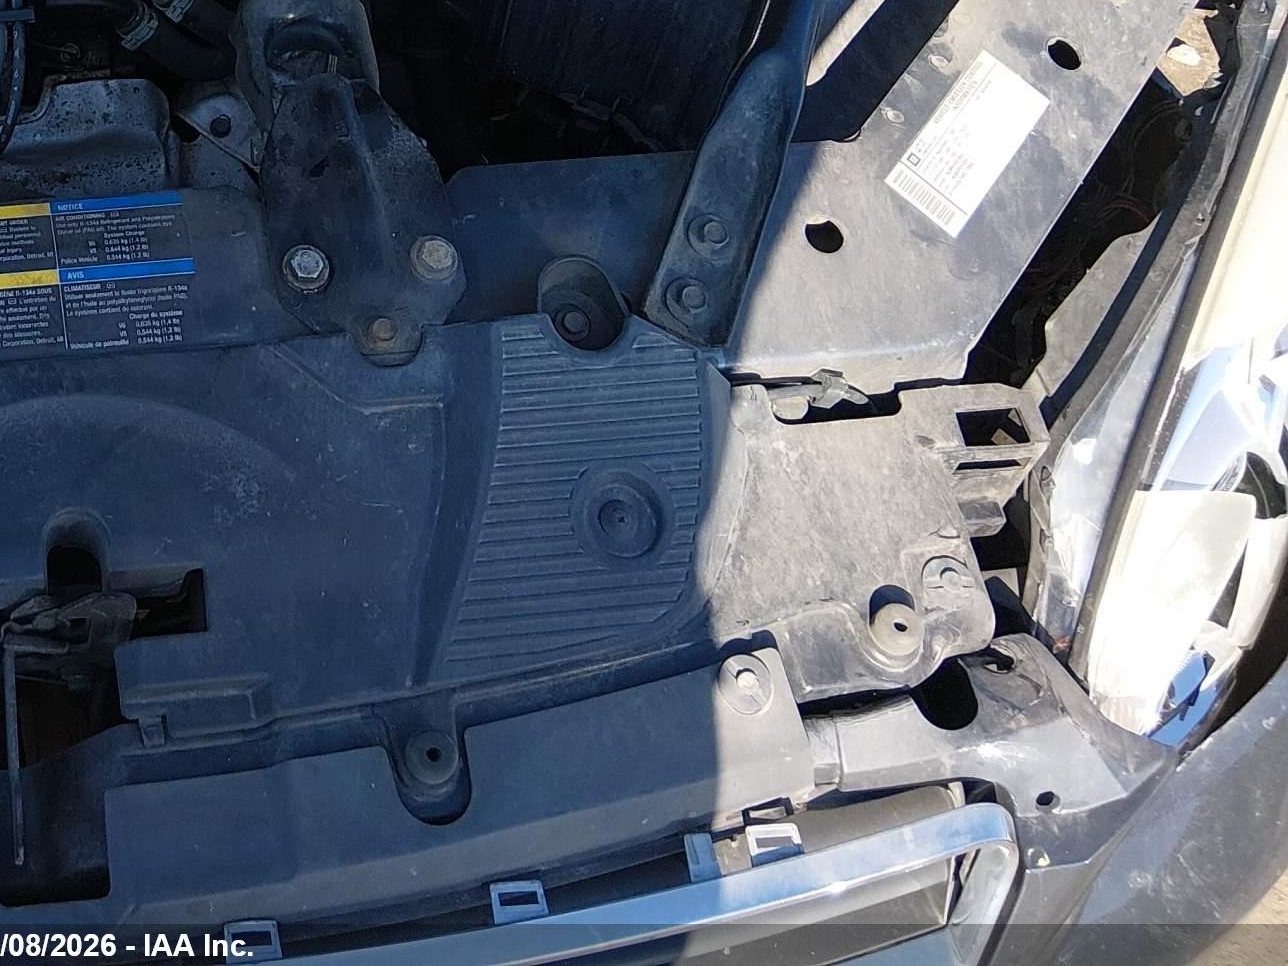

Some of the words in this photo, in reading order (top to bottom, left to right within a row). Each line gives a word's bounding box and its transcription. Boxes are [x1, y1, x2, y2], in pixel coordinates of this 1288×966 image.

[58, 203, 83, 211] NOTICE
[67, 272, 84, 280] AVIS
[64, 283, 101, 292] CLIMATISEUR
[129, 311, 150, 320] Charge
[159, 310, 182, 318] système
